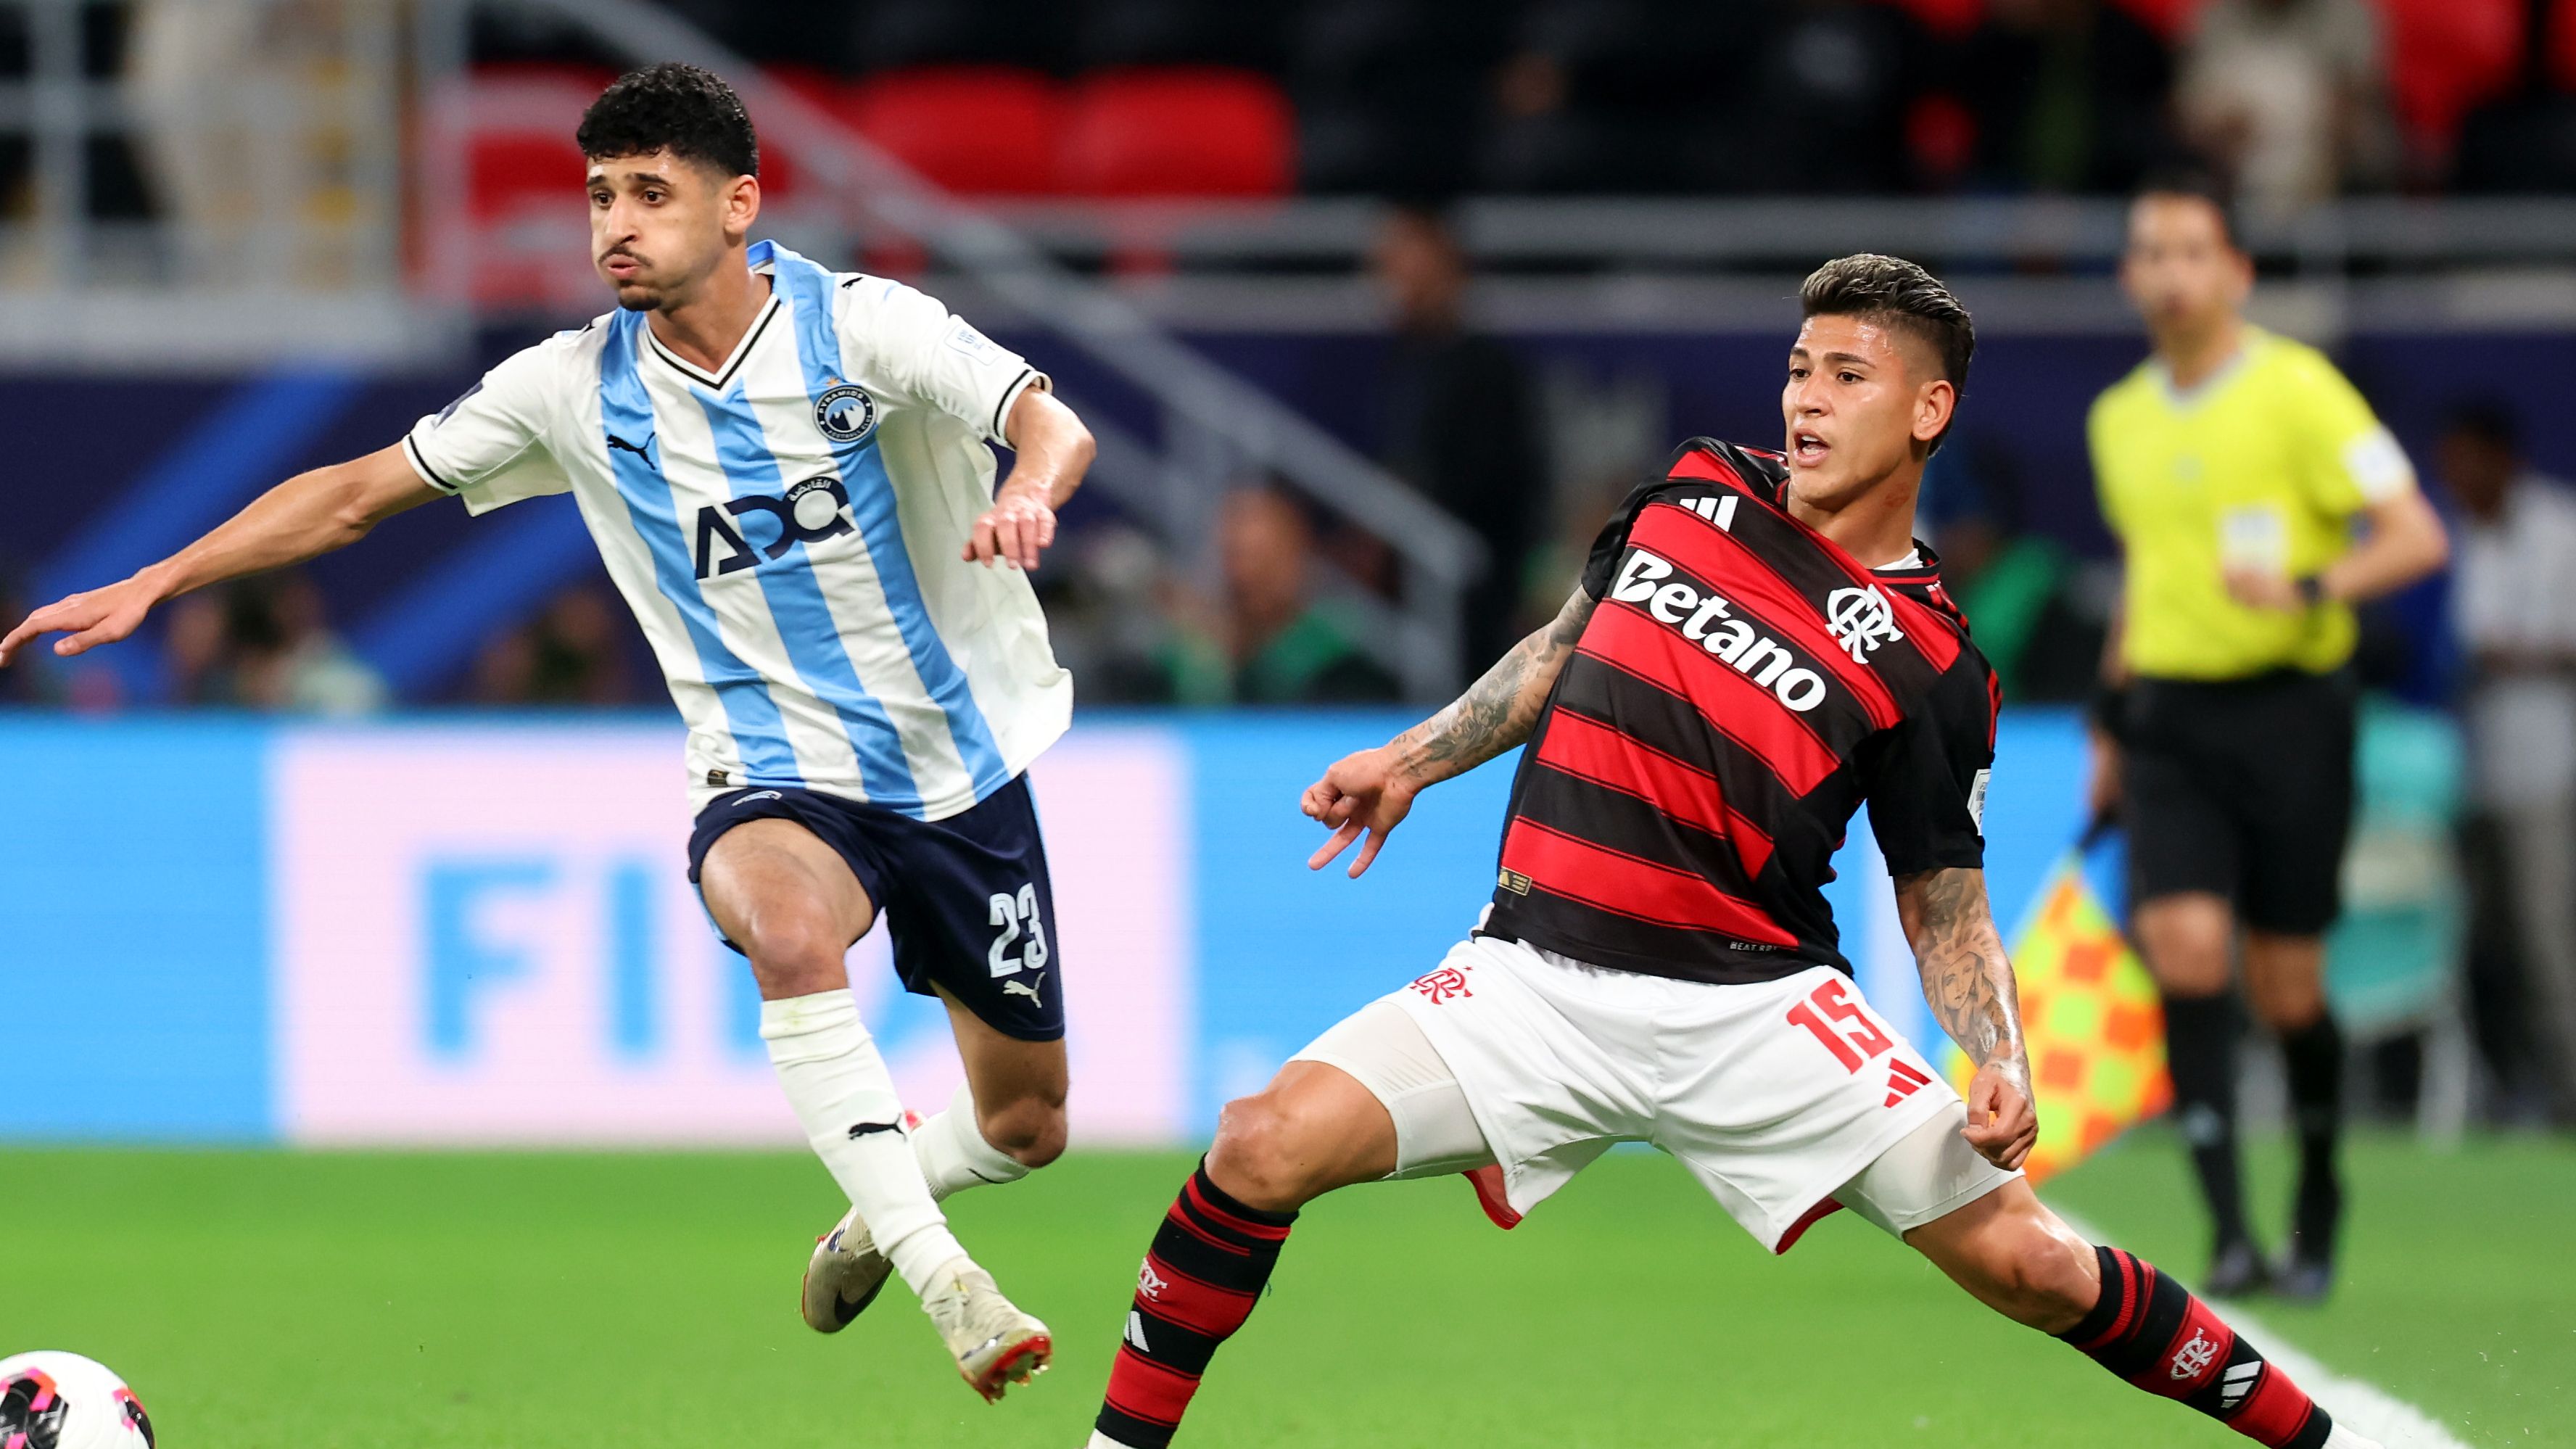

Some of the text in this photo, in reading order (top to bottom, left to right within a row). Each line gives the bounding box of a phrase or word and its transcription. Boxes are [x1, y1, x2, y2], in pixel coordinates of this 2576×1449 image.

[818, 390, 864, 414] PYRAMIDS
[1611, 549, 1826, 711] Betano
[988, 882, 1049, 978] 23
[1786, 978, 1894, 1075] 15
